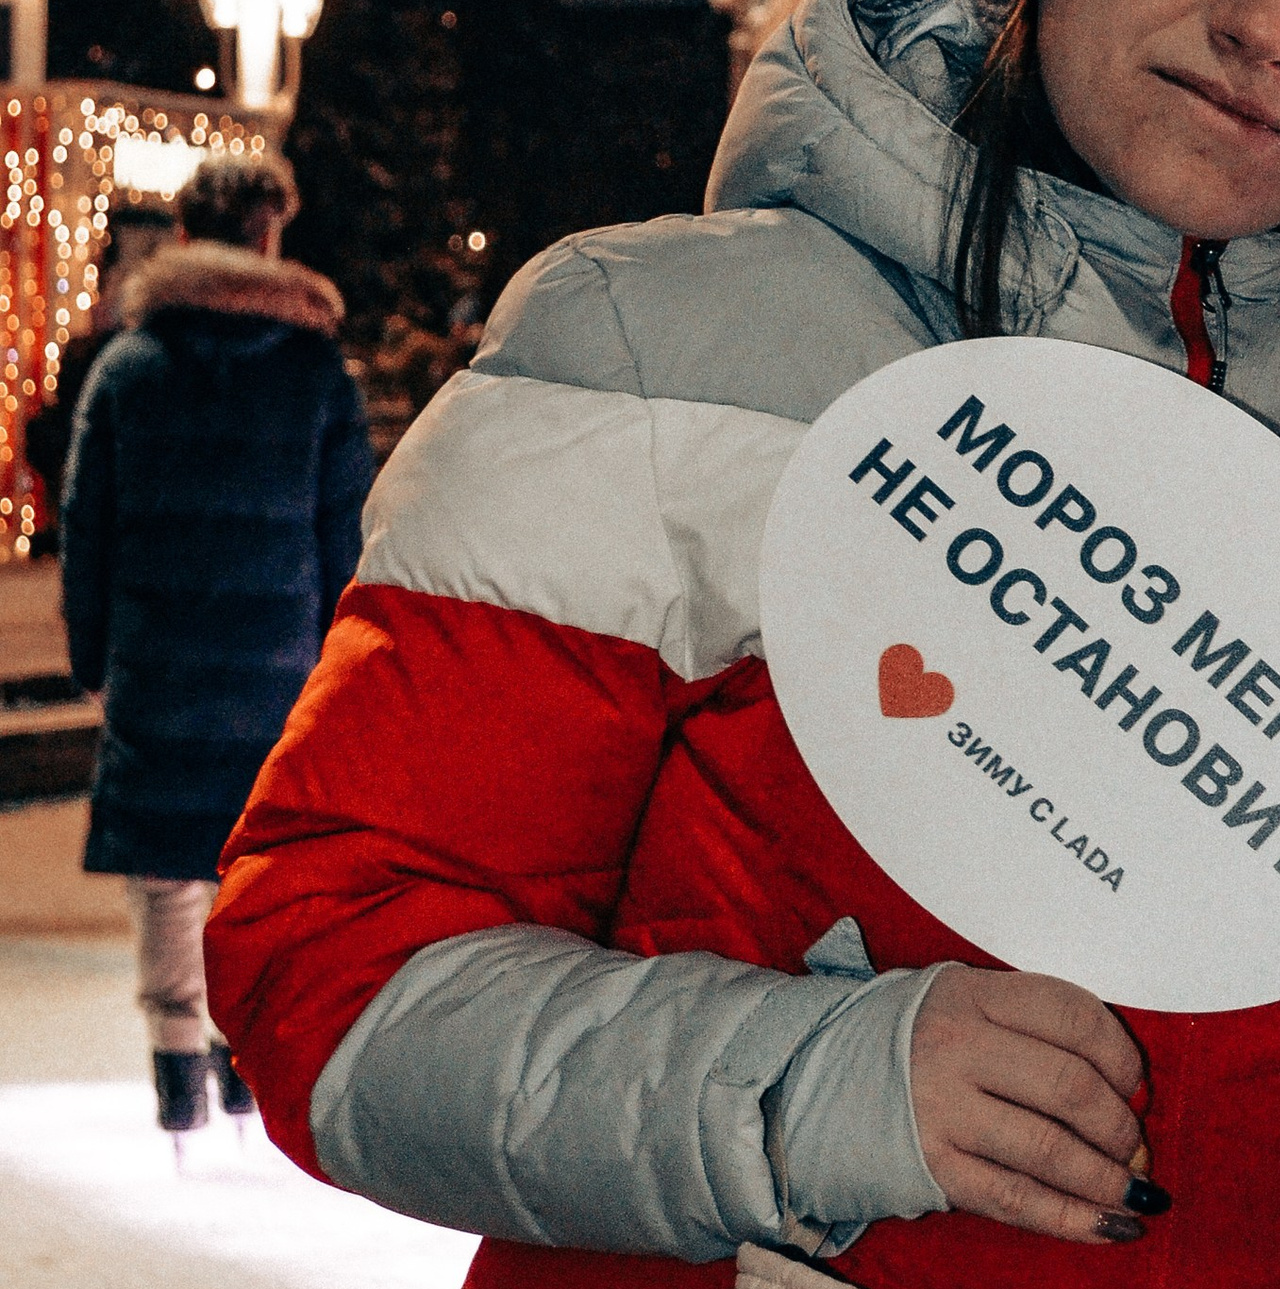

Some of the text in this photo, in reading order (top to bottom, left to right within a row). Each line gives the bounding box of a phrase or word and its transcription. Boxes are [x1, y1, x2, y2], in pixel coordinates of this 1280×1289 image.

[848, 437, 956, 543] НЕ
[936, 394, 1181, 625] МОРОЗ
[947, 722, 1125, 892] ЗИМУ С LADA
